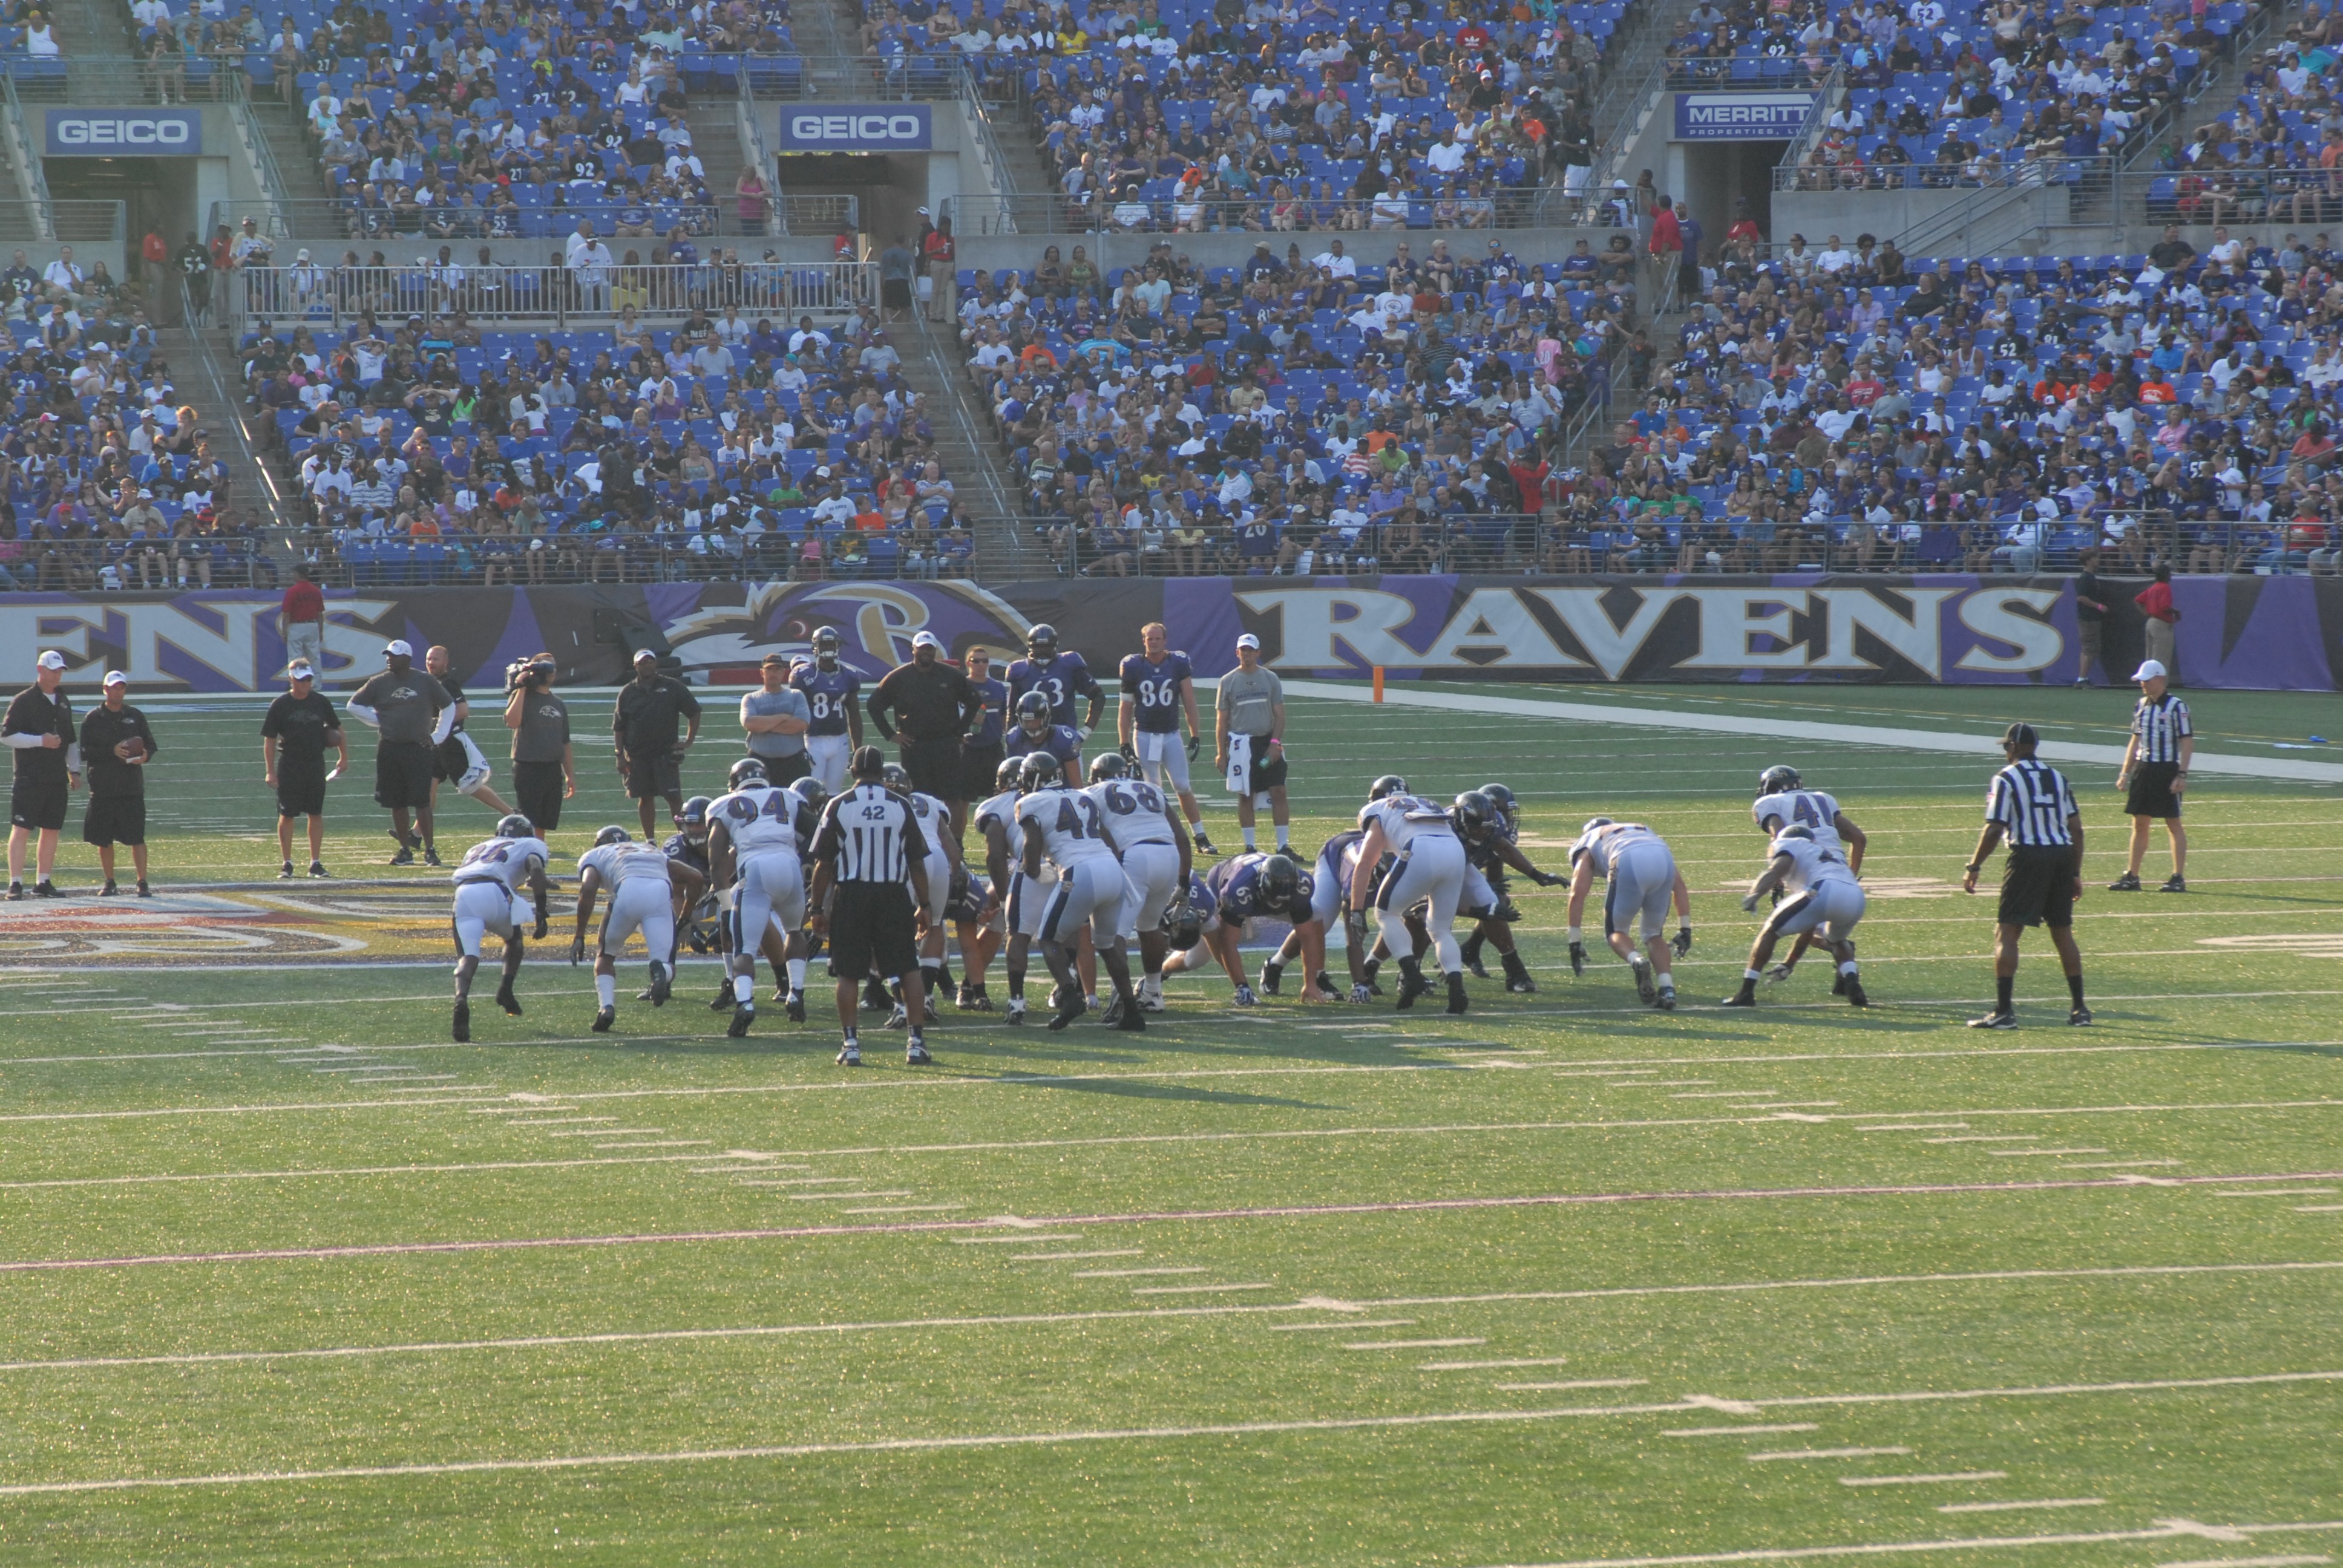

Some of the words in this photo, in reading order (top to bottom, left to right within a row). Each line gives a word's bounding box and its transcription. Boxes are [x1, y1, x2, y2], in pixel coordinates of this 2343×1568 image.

[765, 10, 781, 24] 74
[1918, 10, 1933, 20] 52
[1769, 45, 1786, 57] 92
[2023, 52, 2032, 65] 7
[317, 59, 330, 71] 27
[533, 92, 549, 104] 27
[1689, 106, 1810, 123] MERRITT
[58, 120, 188, 143] GEICO
[792, 116, 919, 139] GEICO
[1689, 128, 1779, 136] PROPERTIES,
[606, 134, 623, 148] 92
[1120, 131, 1127, 143] 5
[510, 168, 522, 181] 27
[575, 162, 595, 177] 92
[1285, 168, 1300, 179] 52
[369, 215, 376, 232] 5
[437, 212, 445, 229] 5
[493, 215, 507, 230] 55
[12, 278, 31, 292] 52
[1483, 341, 1490, 349] 5
[2000, 343, 2016, 356] 52
[1245, 525, 1267, 538] 20
[1231, 587, 2065, 681] RAVENS
[1139, 679, 1173, 707] 86
[814, 693, 846, 719] 84
[1062, 728, 1073, 739] 6
[2028, 771, 2054, 803] L
[1104, 782, 1162, 815] 68
[727, 791, 788, 825] 94
[862, 805, 885, 821] 42
[1793, 795, 1835, 829] 41
[1056, 797, 1101, 840] 42
[665, 838, 680, 857] 89
[1297, 877, 1310, 895] 65
[963, 890, 980, 910] 71
[1236, 886, 1253, 906] 65
